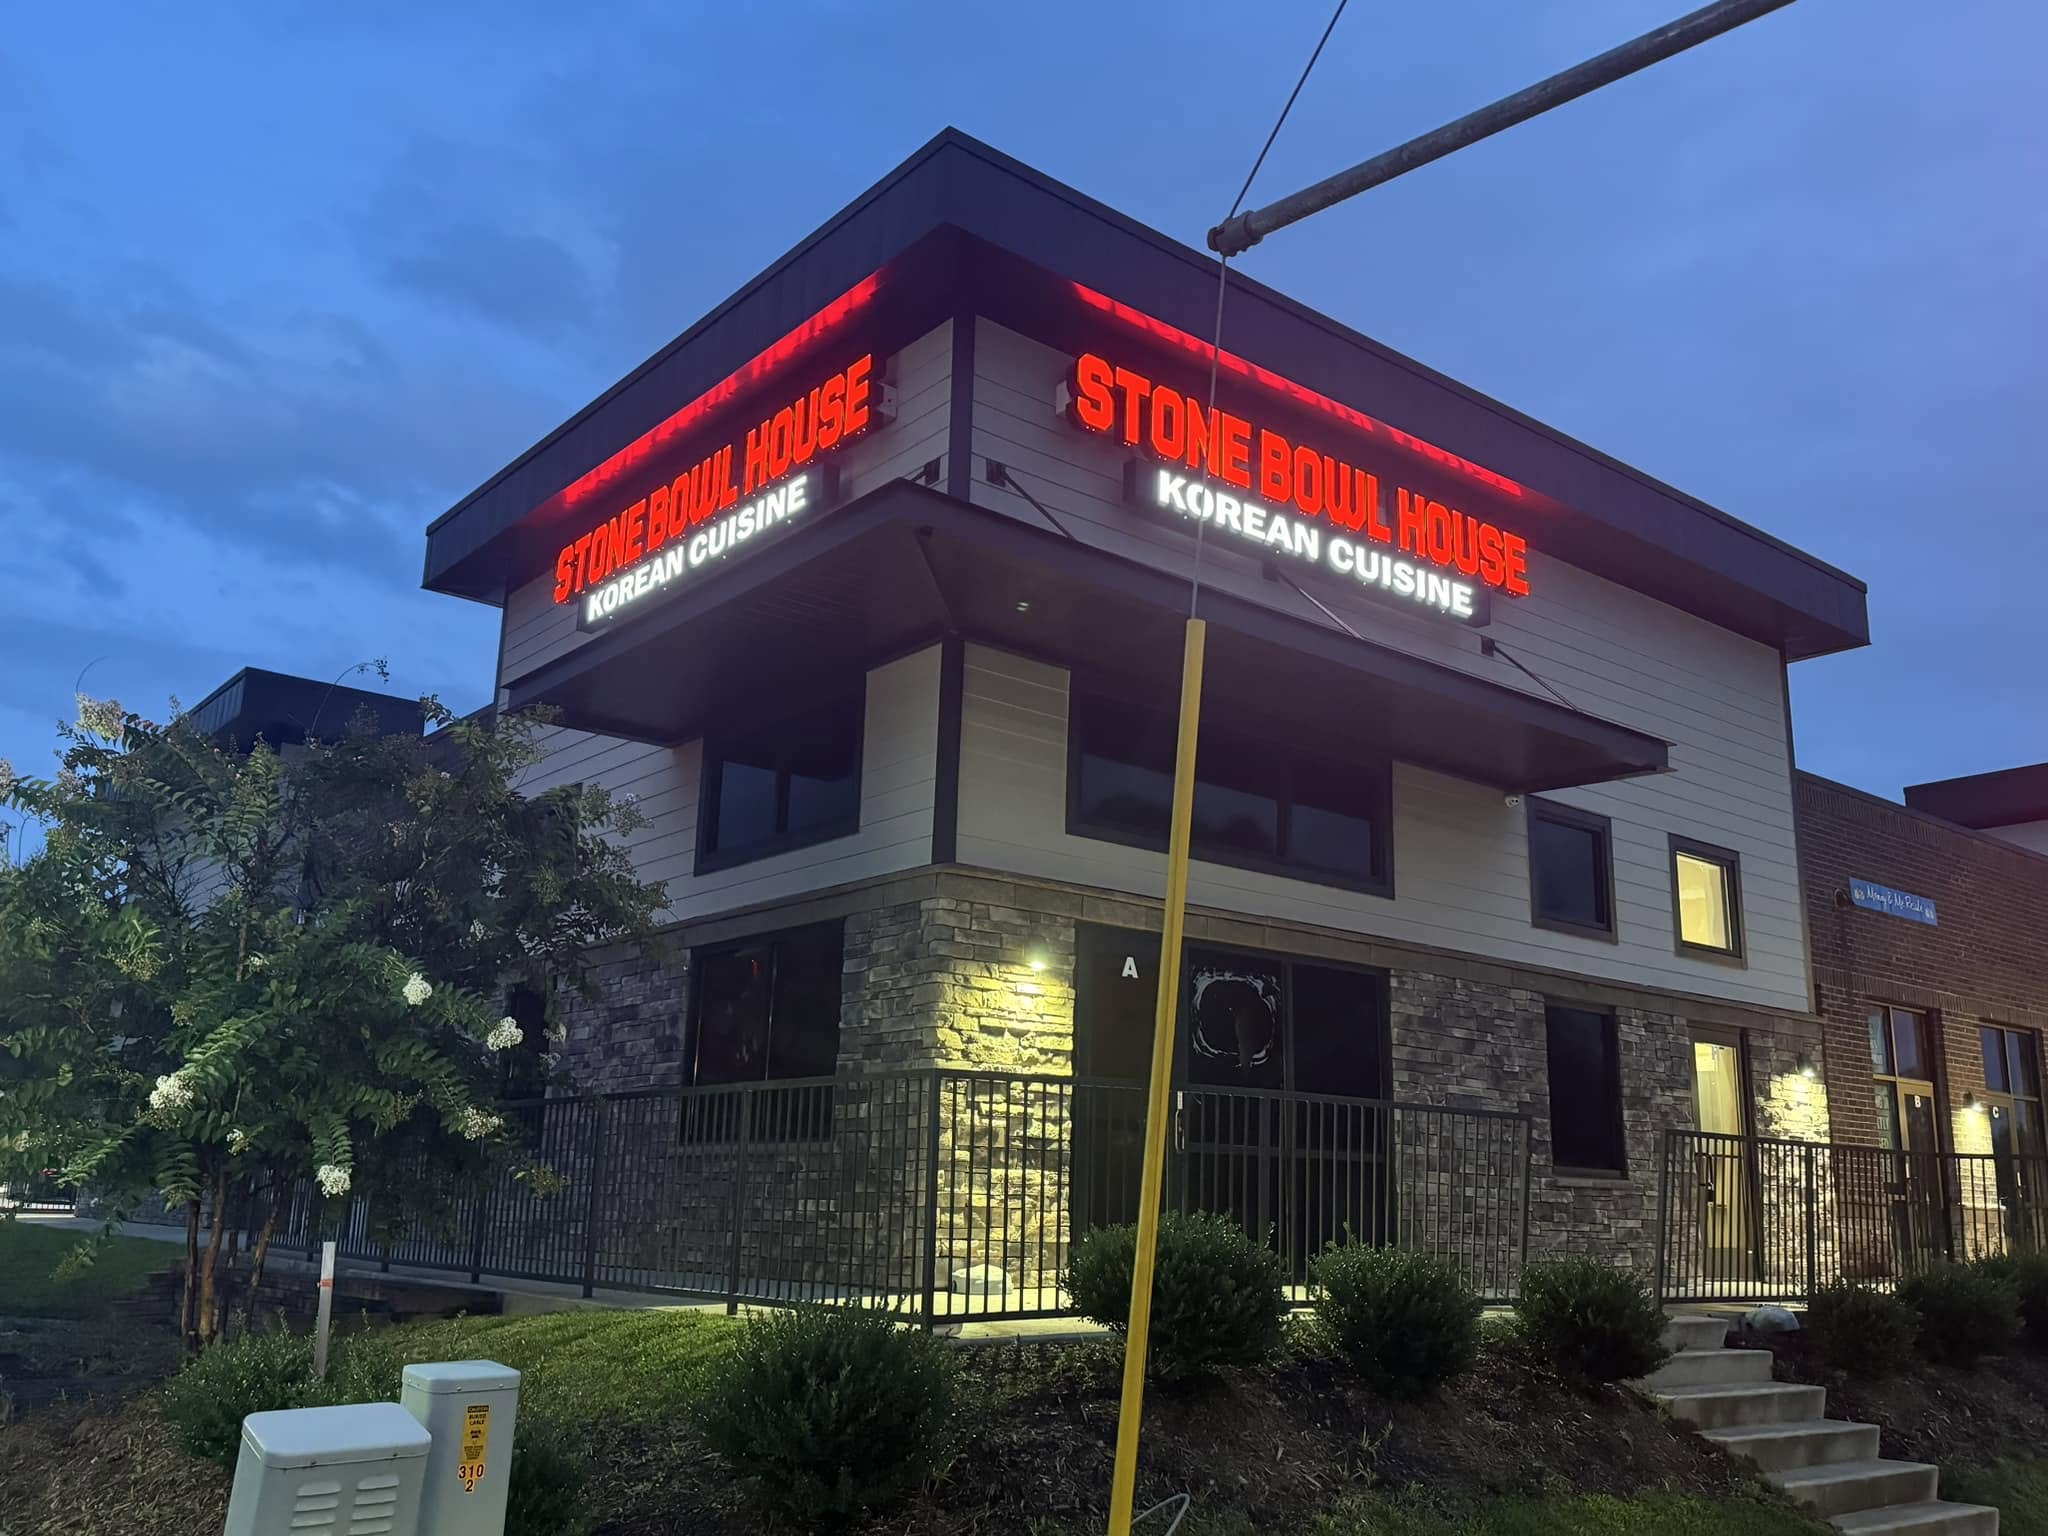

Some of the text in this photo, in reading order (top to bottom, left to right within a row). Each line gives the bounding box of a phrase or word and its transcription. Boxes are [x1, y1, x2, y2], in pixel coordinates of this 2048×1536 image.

[553, 353, 872, 604] STONE BOWL HOUSE
[1076, 353, 1530, 597] STONE BOWL HOUSE
[587, 474, 808, 623] KOREAN CUISINE
[1158, 469, 1474, 616] KOREAN CUISINE
[1121, 956, 1139, 979] A
[1992, 1106, 1999, 1119] C
[458, 1464, 484, 1479] 310
[465, 1479, 474, 1492] 2
